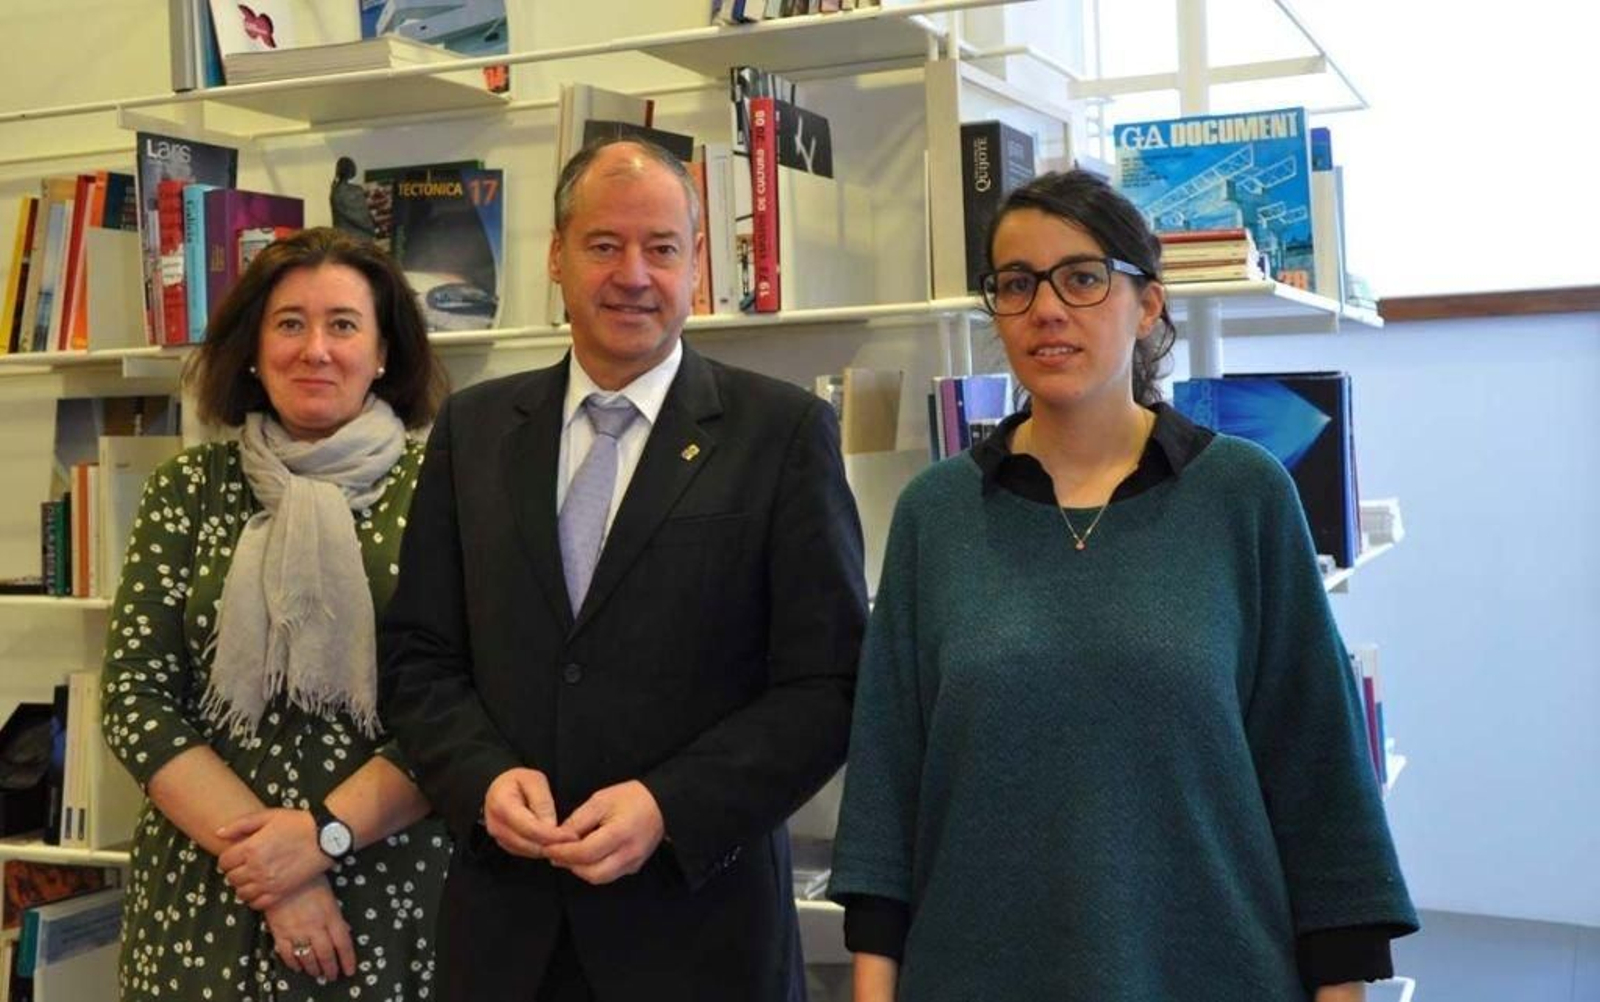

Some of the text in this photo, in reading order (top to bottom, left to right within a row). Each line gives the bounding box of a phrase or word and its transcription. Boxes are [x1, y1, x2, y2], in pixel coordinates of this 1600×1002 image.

[1120, 111, 1298, 150] GA DOCUMENT
[756, 149, 767, 195] CULTURA
[469, 177, 499, 207] 17
[757, 197, 767, 212] DE
